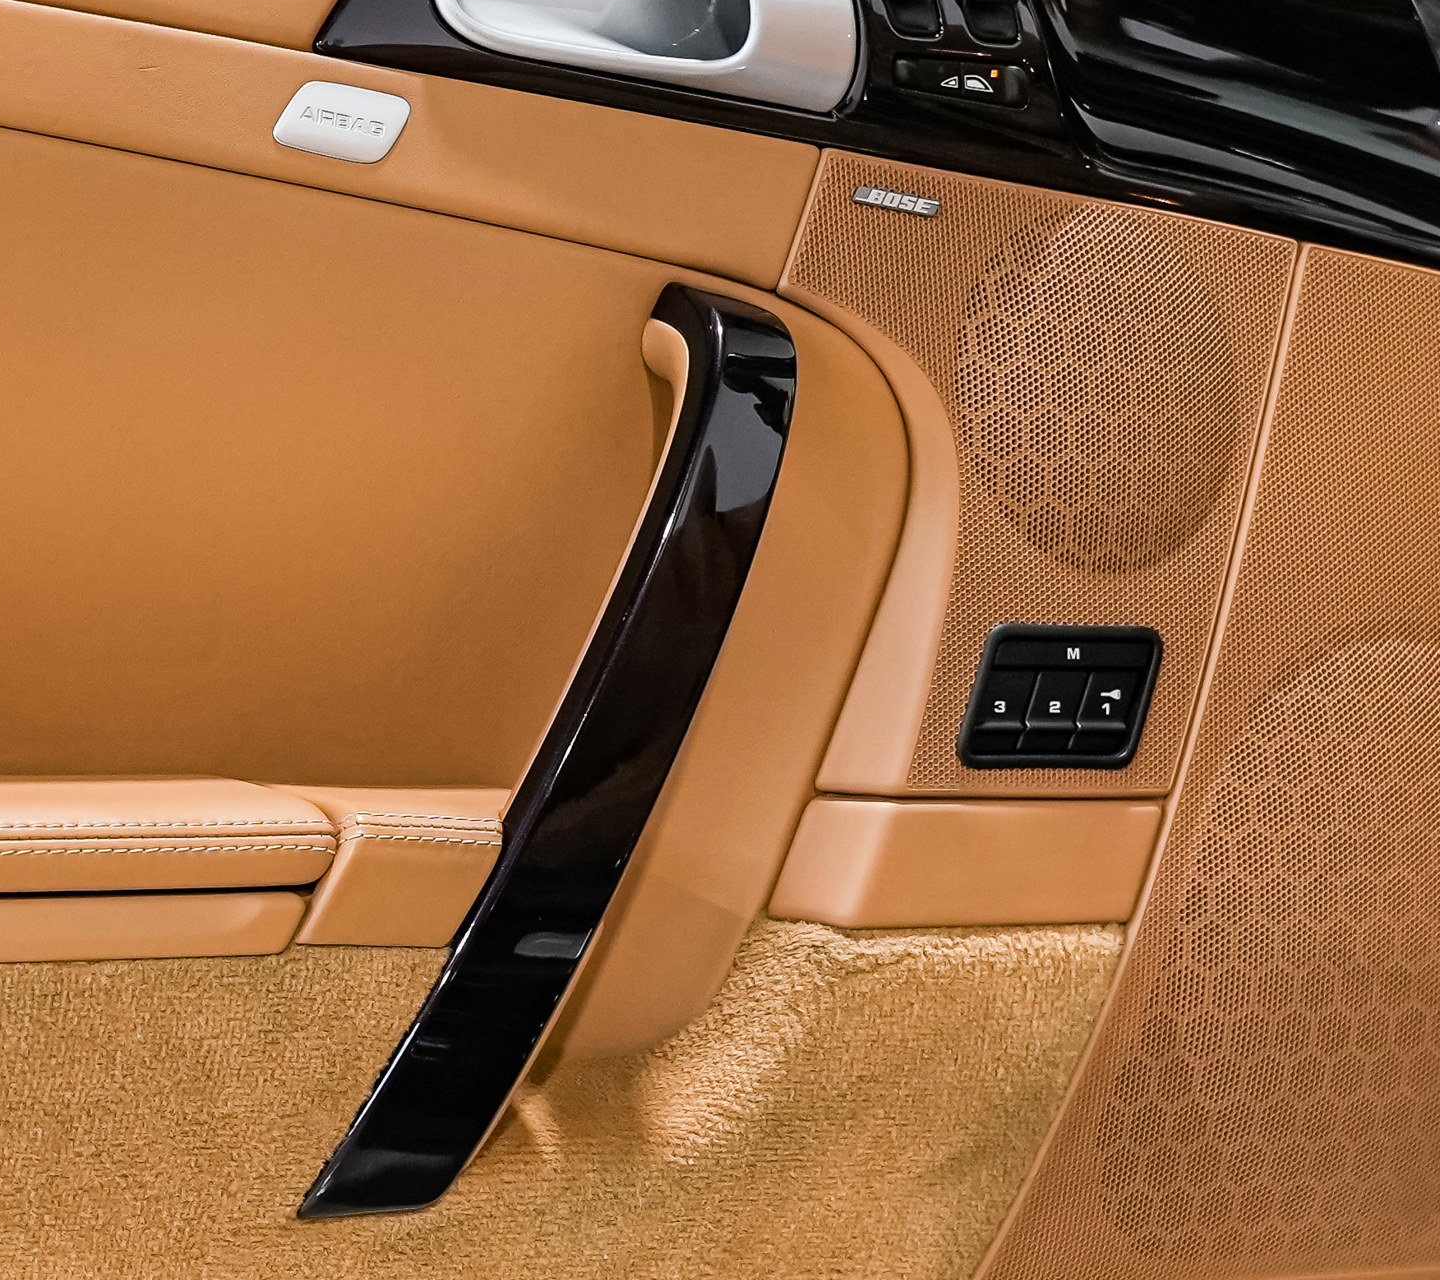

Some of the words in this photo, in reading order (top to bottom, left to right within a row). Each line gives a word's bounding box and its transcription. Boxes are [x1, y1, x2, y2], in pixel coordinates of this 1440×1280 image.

[299, 105, 386, 138] AIRBAG
[867, 188, 940, 214] BOSE
[1066, 647, 1081, 660] M
[993, 700, 1007, 714] 3
[1048, 700, 1061, 714] 2
[1101, 702, 1111, 716] 1
